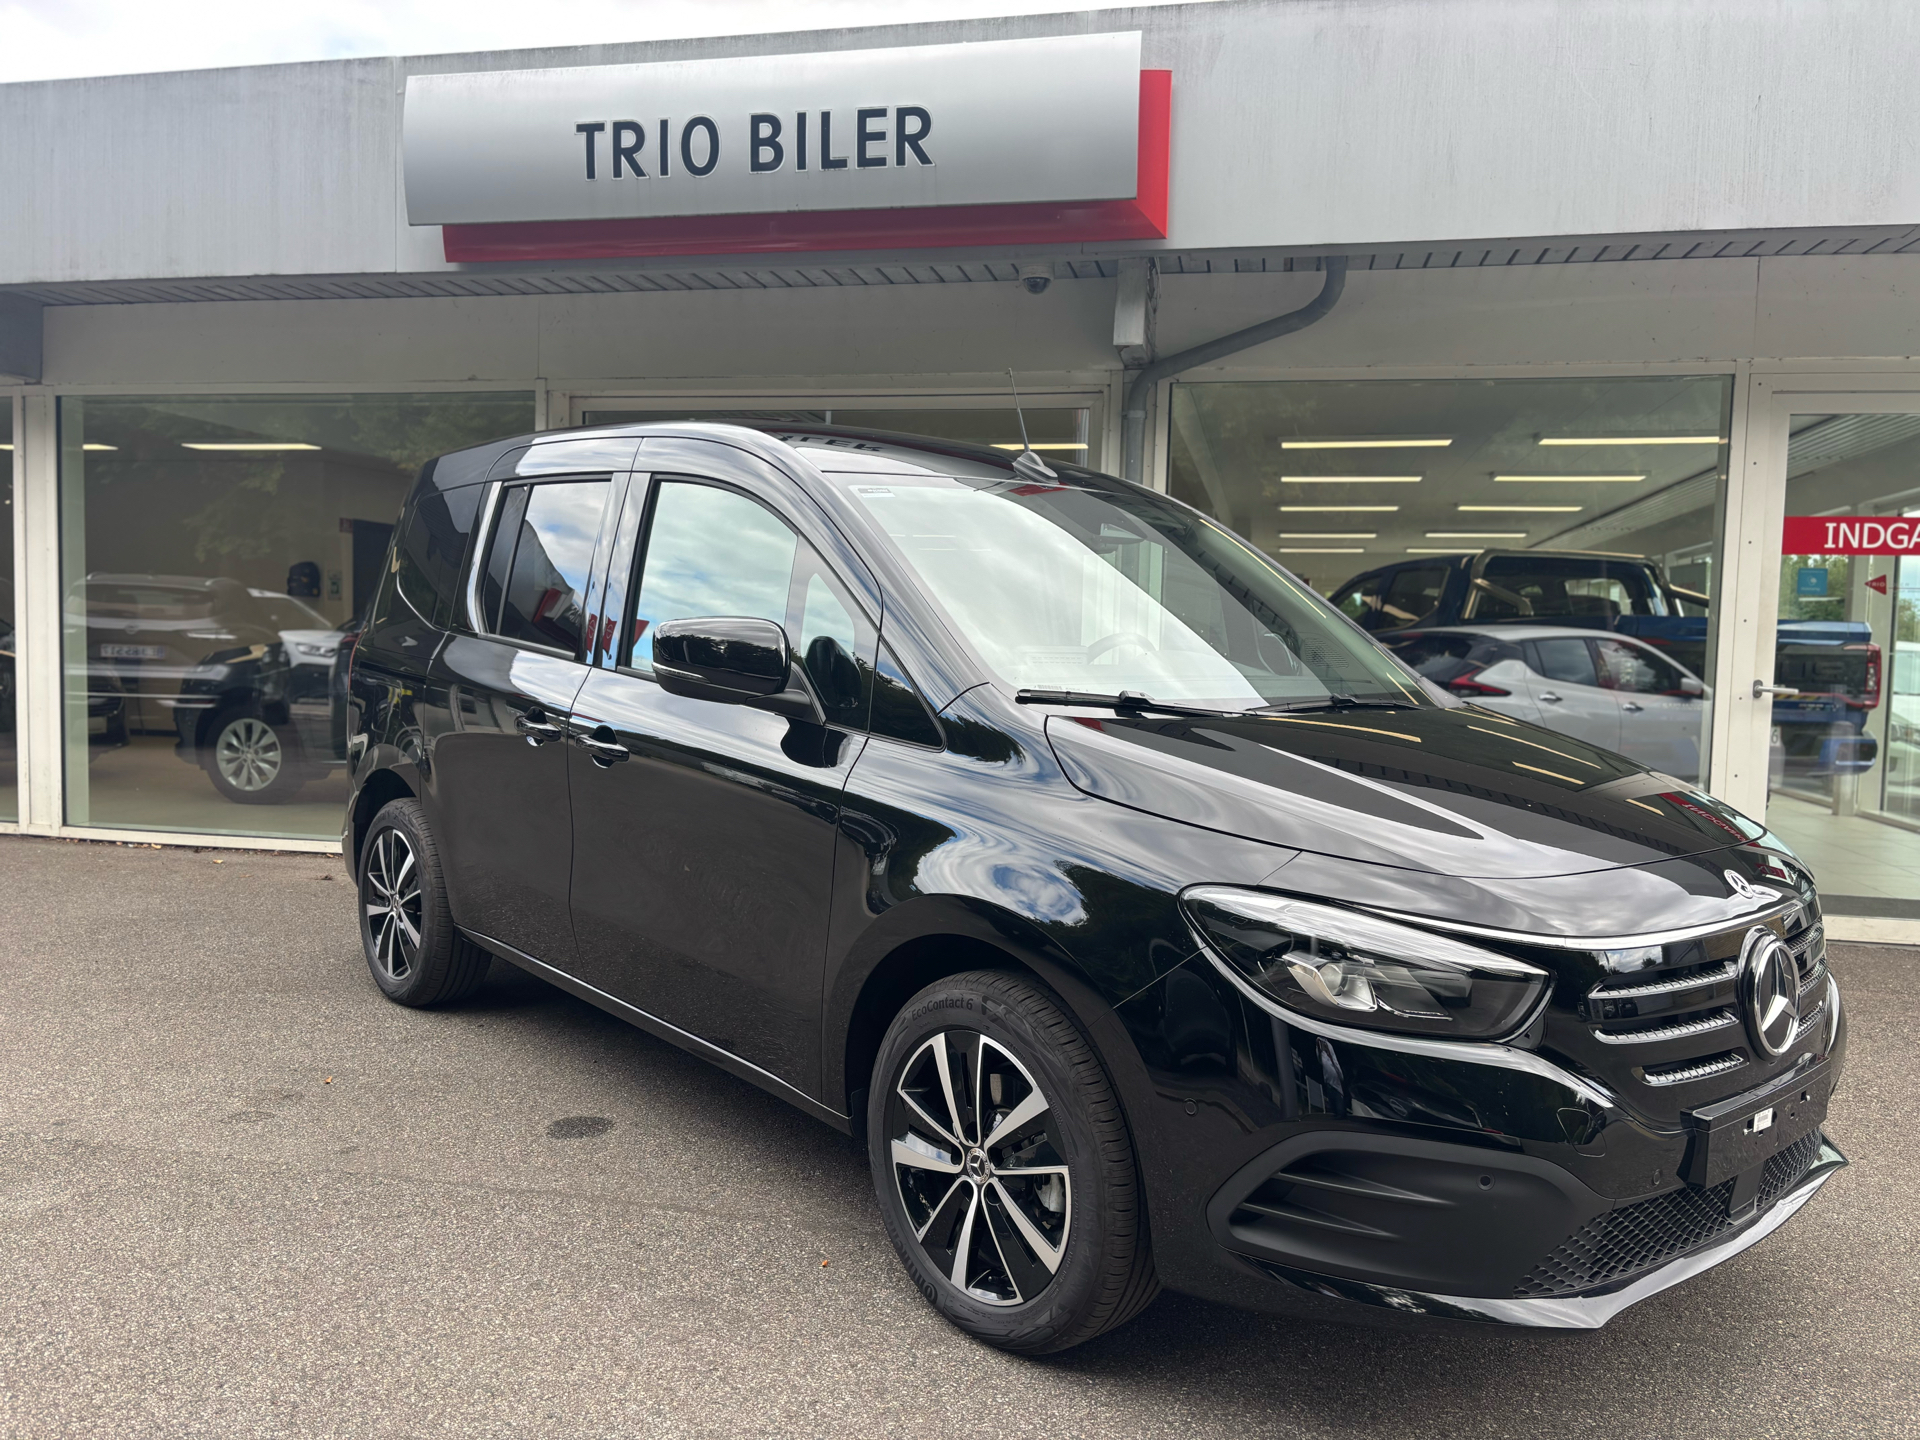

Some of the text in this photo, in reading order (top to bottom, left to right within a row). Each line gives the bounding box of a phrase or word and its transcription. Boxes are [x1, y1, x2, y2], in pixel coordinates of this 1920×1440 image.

[574, 104, 936, 182] TRIO BILER
[911, 997, 974, 1021] EcoContact 6
